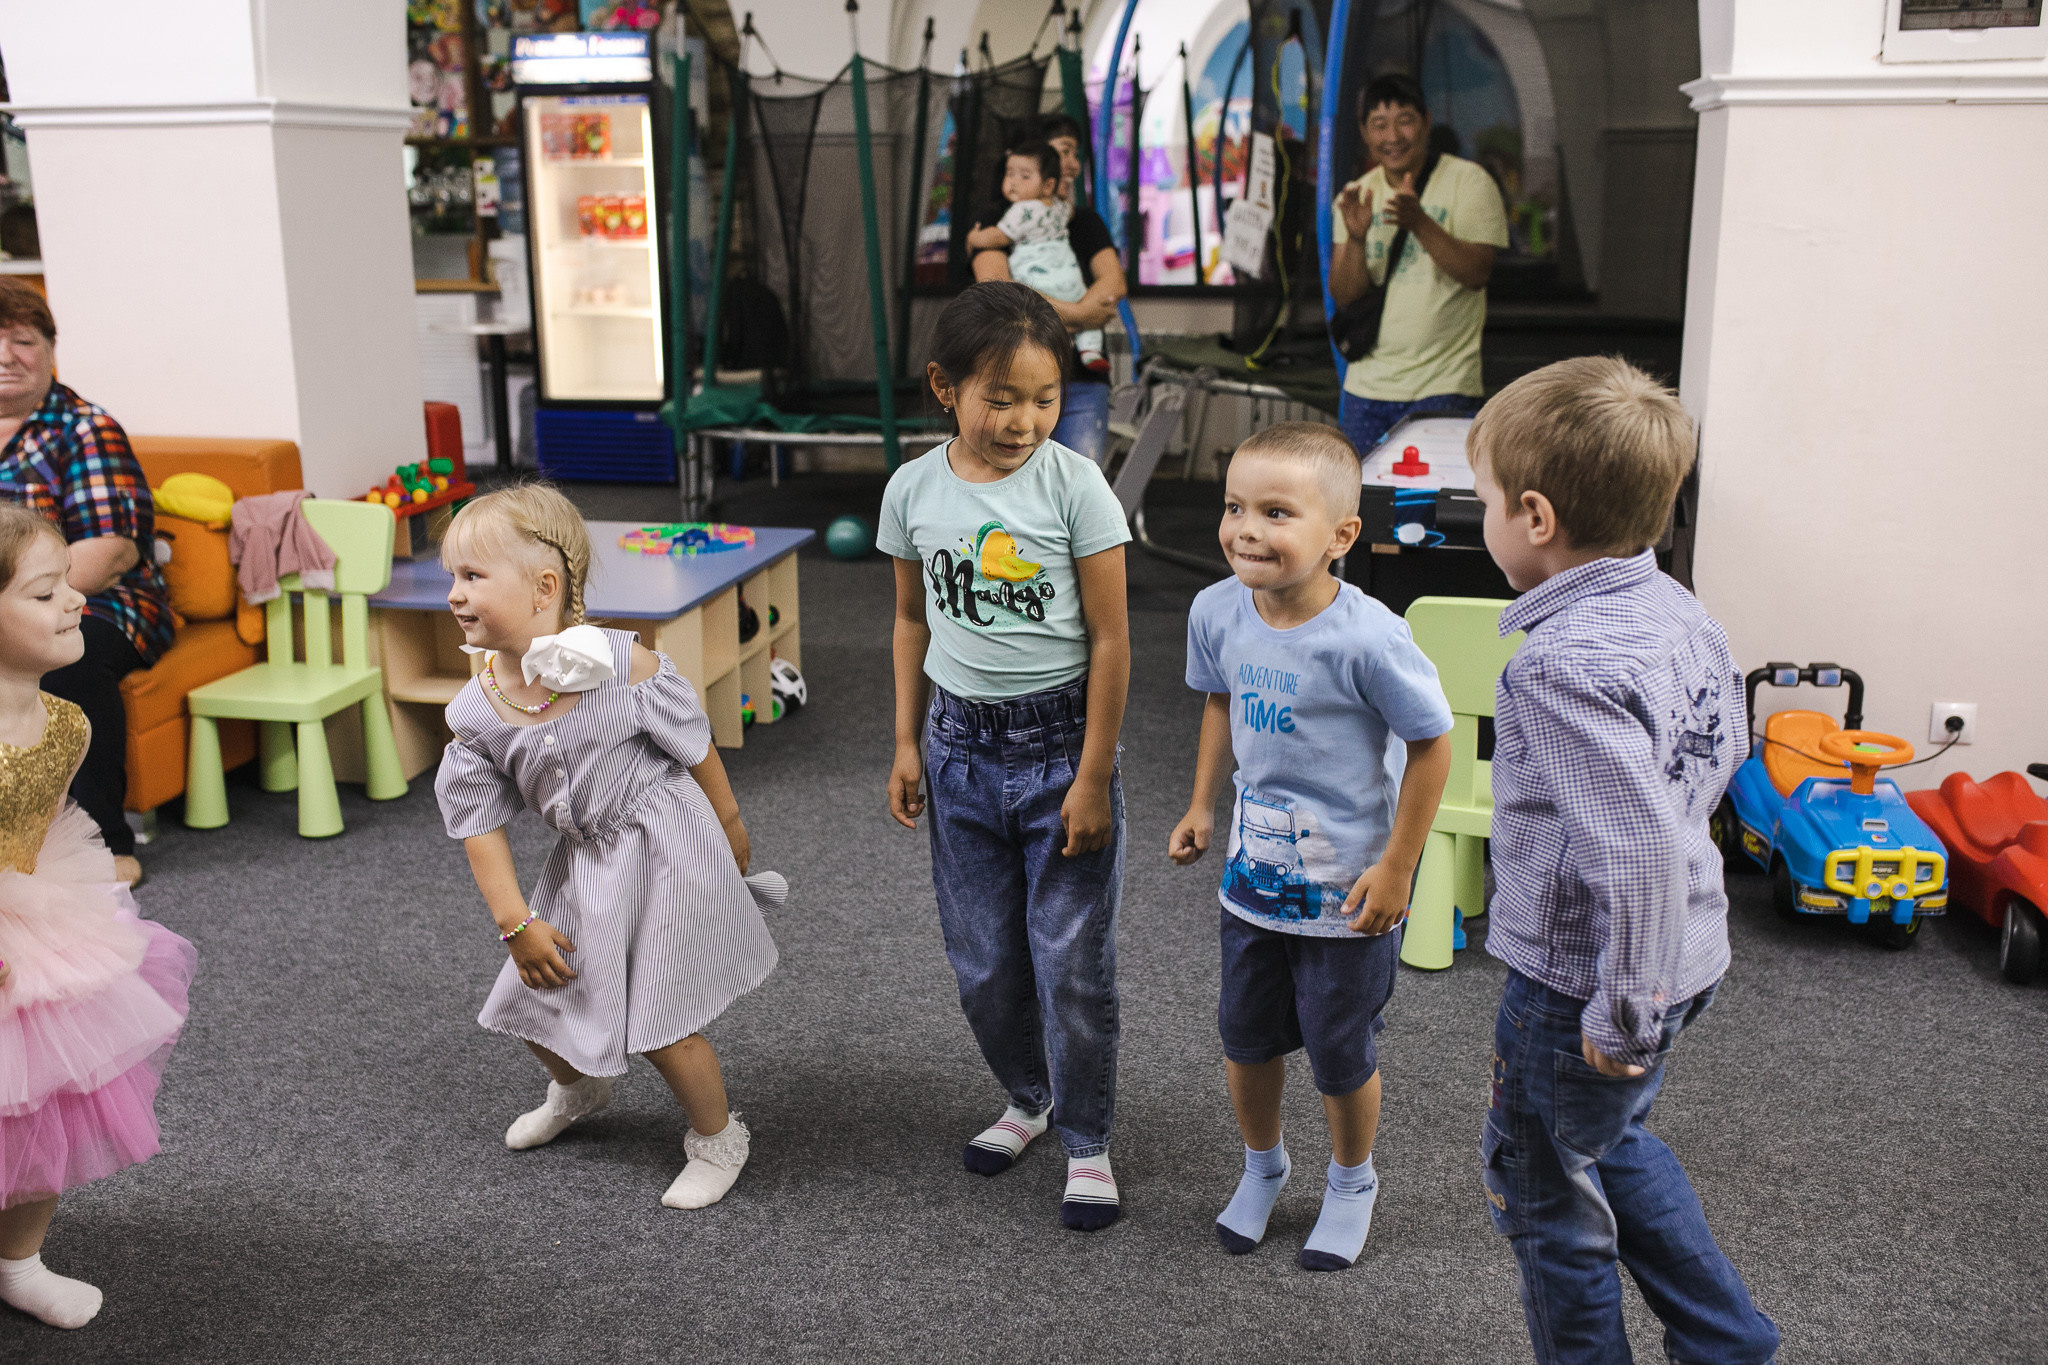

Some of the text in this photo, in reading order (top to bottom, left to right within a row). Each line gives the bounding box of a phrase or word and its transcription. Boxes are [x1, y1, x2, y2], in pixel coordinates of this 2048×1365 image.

[926, 549, 1055, 627] Mango
[1239, 663, 1300, 696] ADVENTURE
[1241, 692, 1296, 734] TIME
